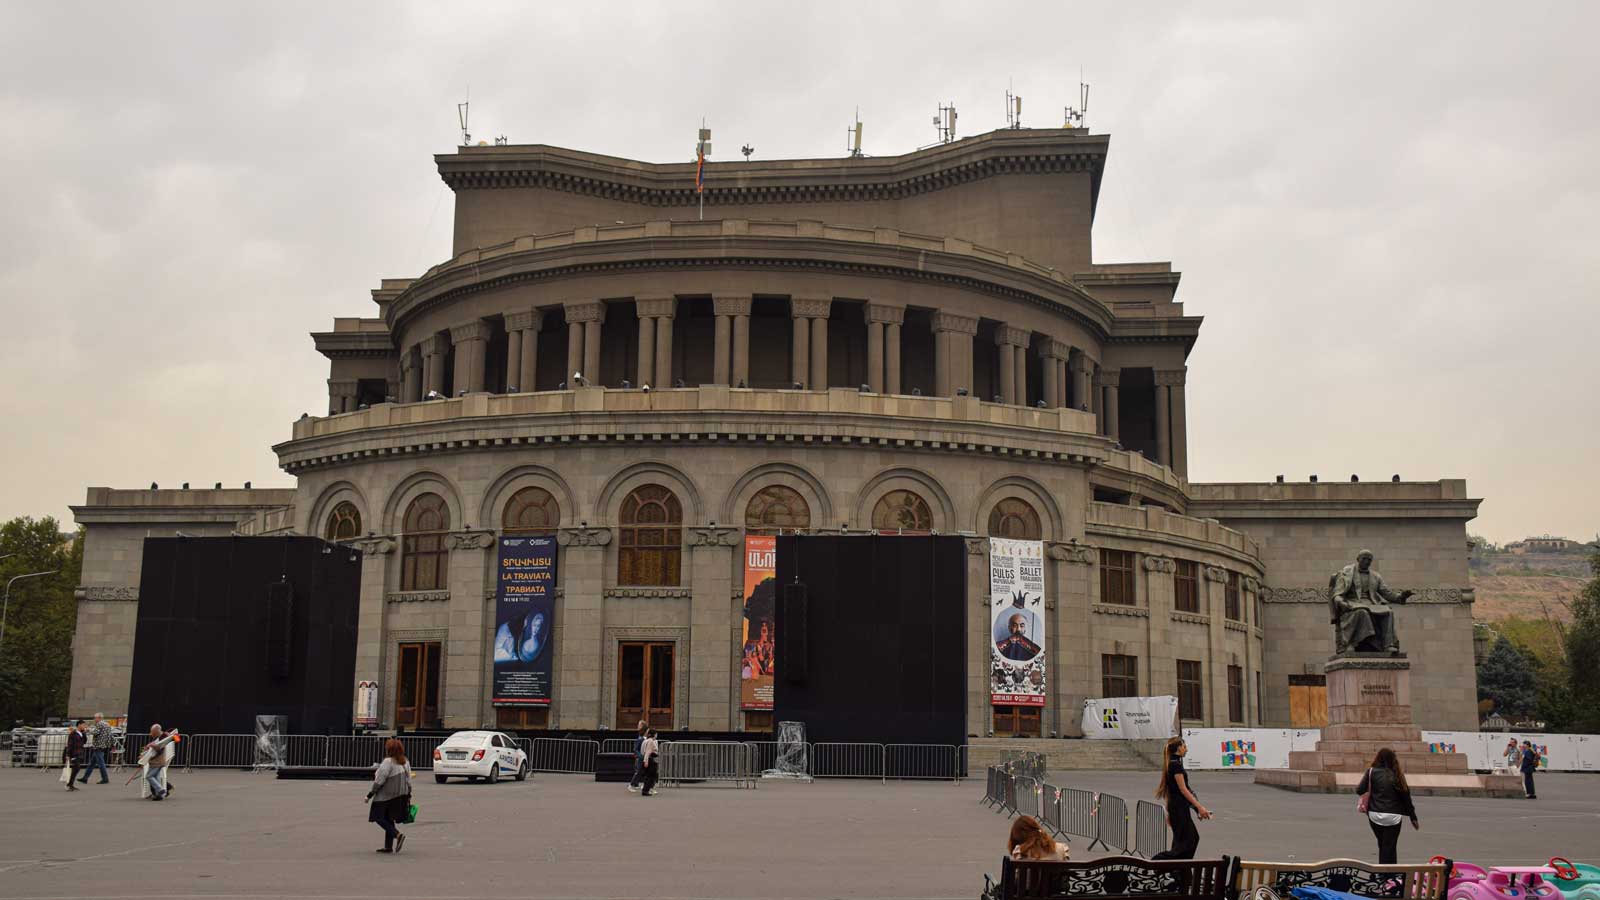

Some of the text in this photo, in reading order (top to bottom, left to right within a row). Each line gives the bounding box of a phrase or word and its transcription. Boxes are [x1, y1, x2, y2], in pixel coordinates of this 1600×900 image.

[503, 558, 551, 566] ՏՐԱՎԻԱՏԱ
[749, 552, 776, 567] ԱՆՈՒ
[1020, 567, 1041, 576] BALLET
